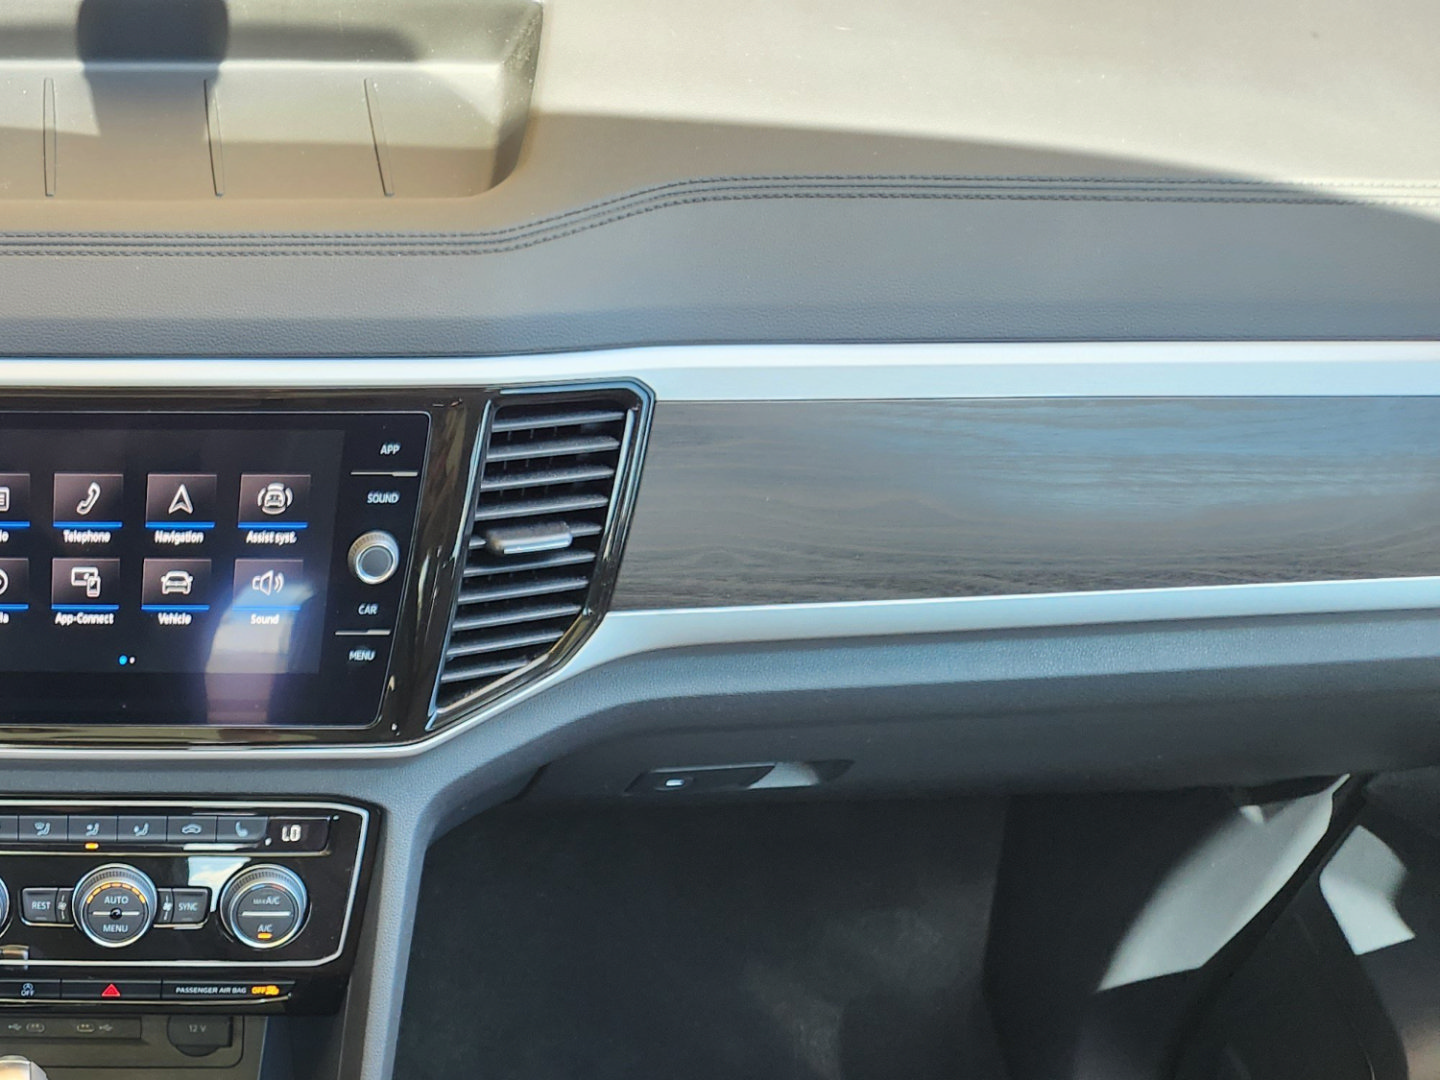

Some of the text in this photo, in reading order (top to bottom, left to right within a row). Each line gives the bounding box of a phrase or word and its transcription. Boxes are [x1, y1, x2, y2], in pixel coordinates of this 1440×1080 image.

[380, 443, 400, 455] APP
[367, 492, 399, 504] SOUND
[63, 530, 111, 545] Telephone
[154, 530, 204, 545] Navigation
[245, 531, 297, 545] Assist syst.
[357, 604, 378, 615] CAR
[55, 612, 114, 627] App-Connect
[158, 612, 192, 626] Vehicle
[250, 613, 280, 625] Sound
[348, 650, 375, 661] MENU
[104, 895, 129, 904] AUTO
[266, 895, 280, 905] A/C
[31, 901, 51, 910] REST
[178, 902, 199, 911] SYNC
[102, 924, 129, 933] MENU
[257, 924, 273, 933] A/C
[21, 989, 35, 997] OFF
[188, 1024, 207, 1033] 12 V
